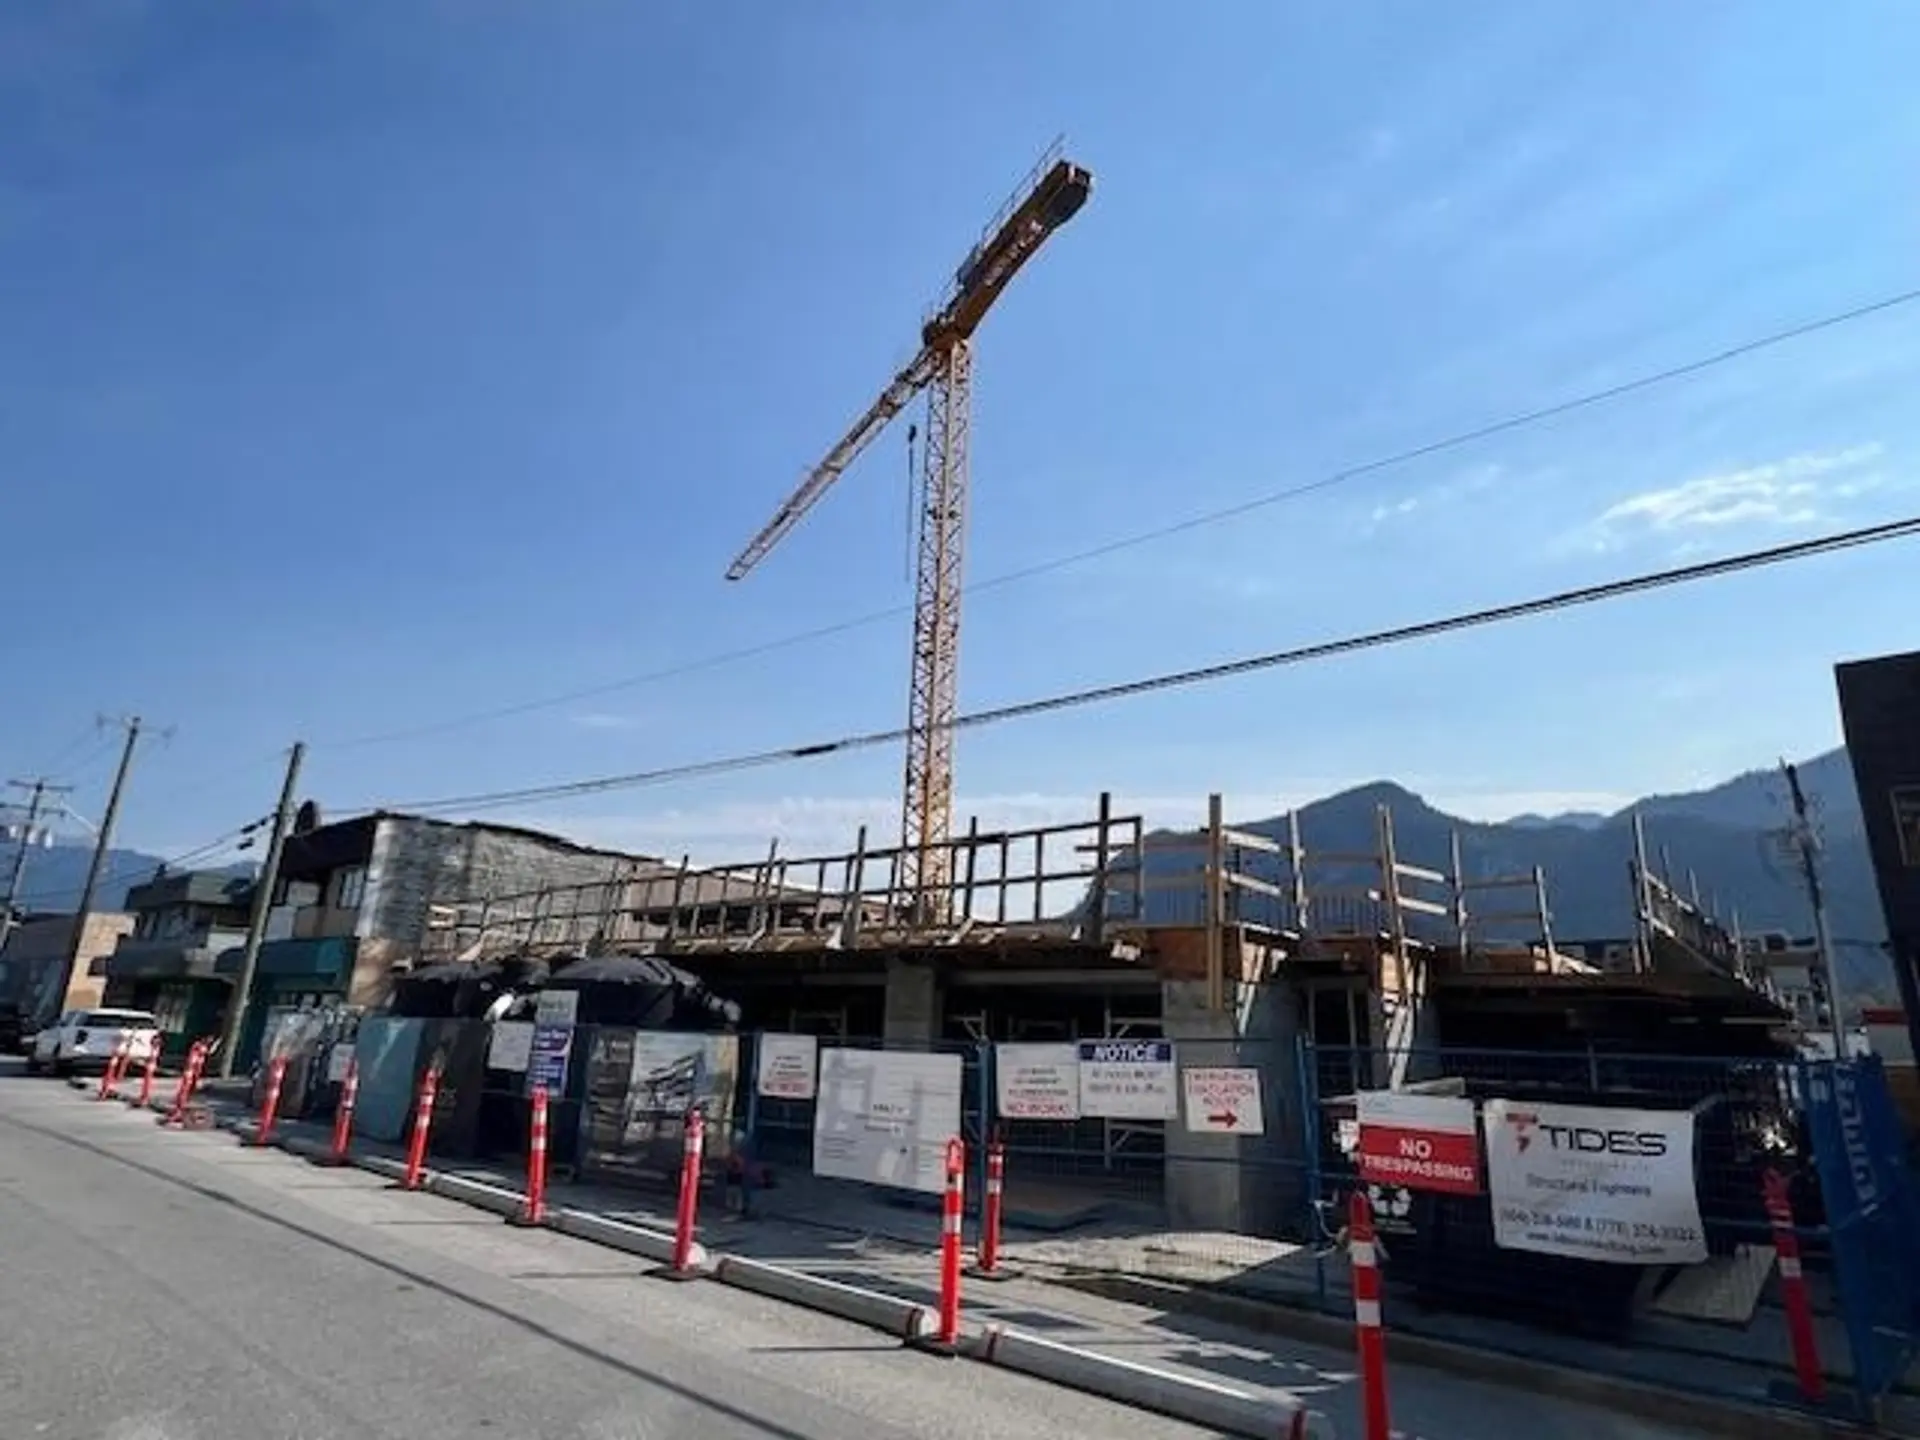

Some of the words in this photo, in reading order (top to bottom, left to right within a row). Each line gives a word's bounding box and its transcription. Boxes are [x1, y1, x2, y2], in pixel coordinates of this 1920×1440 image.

[1091, 1044, 1157, 1062] NOTICE
[1399, 1138, 1432, 1159] NO
[1538, 1124, 1667, 1157] TIDES
[1362, 1153, 1475, 1181] TRESPASSING
